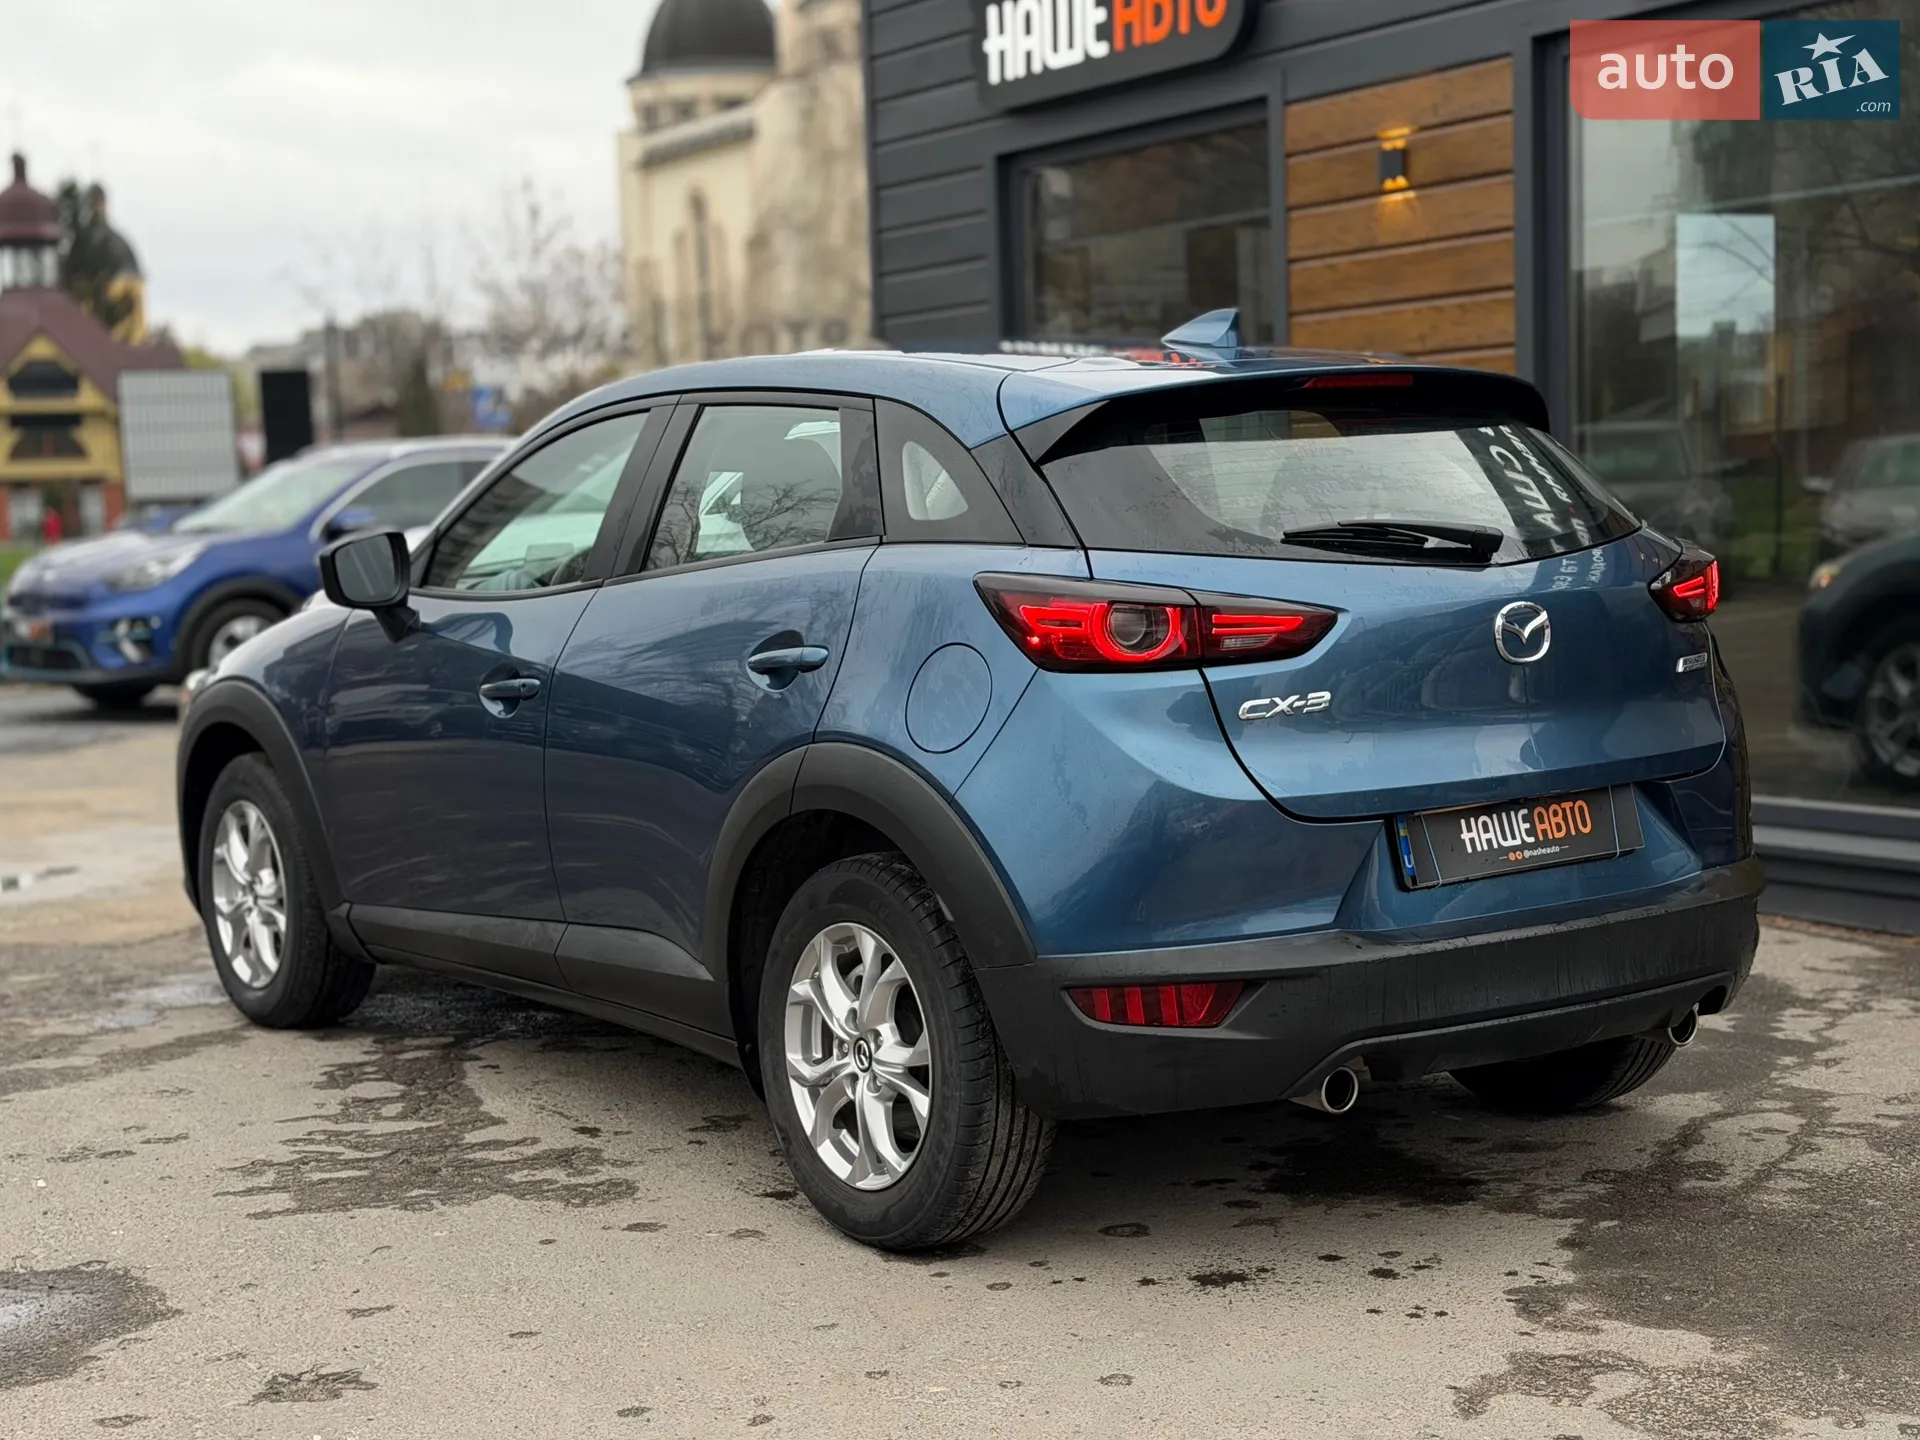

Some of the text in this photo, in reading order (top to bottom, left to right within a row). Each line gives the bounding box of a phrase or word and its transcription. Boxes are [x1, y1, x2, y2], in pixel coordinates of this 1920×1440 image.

[982, 0, 1110, 85] НАШЕ
[1238, 691, 1332, 720] CX-3
[1460, 800, 1592, 853] НАШЕ АВТО
